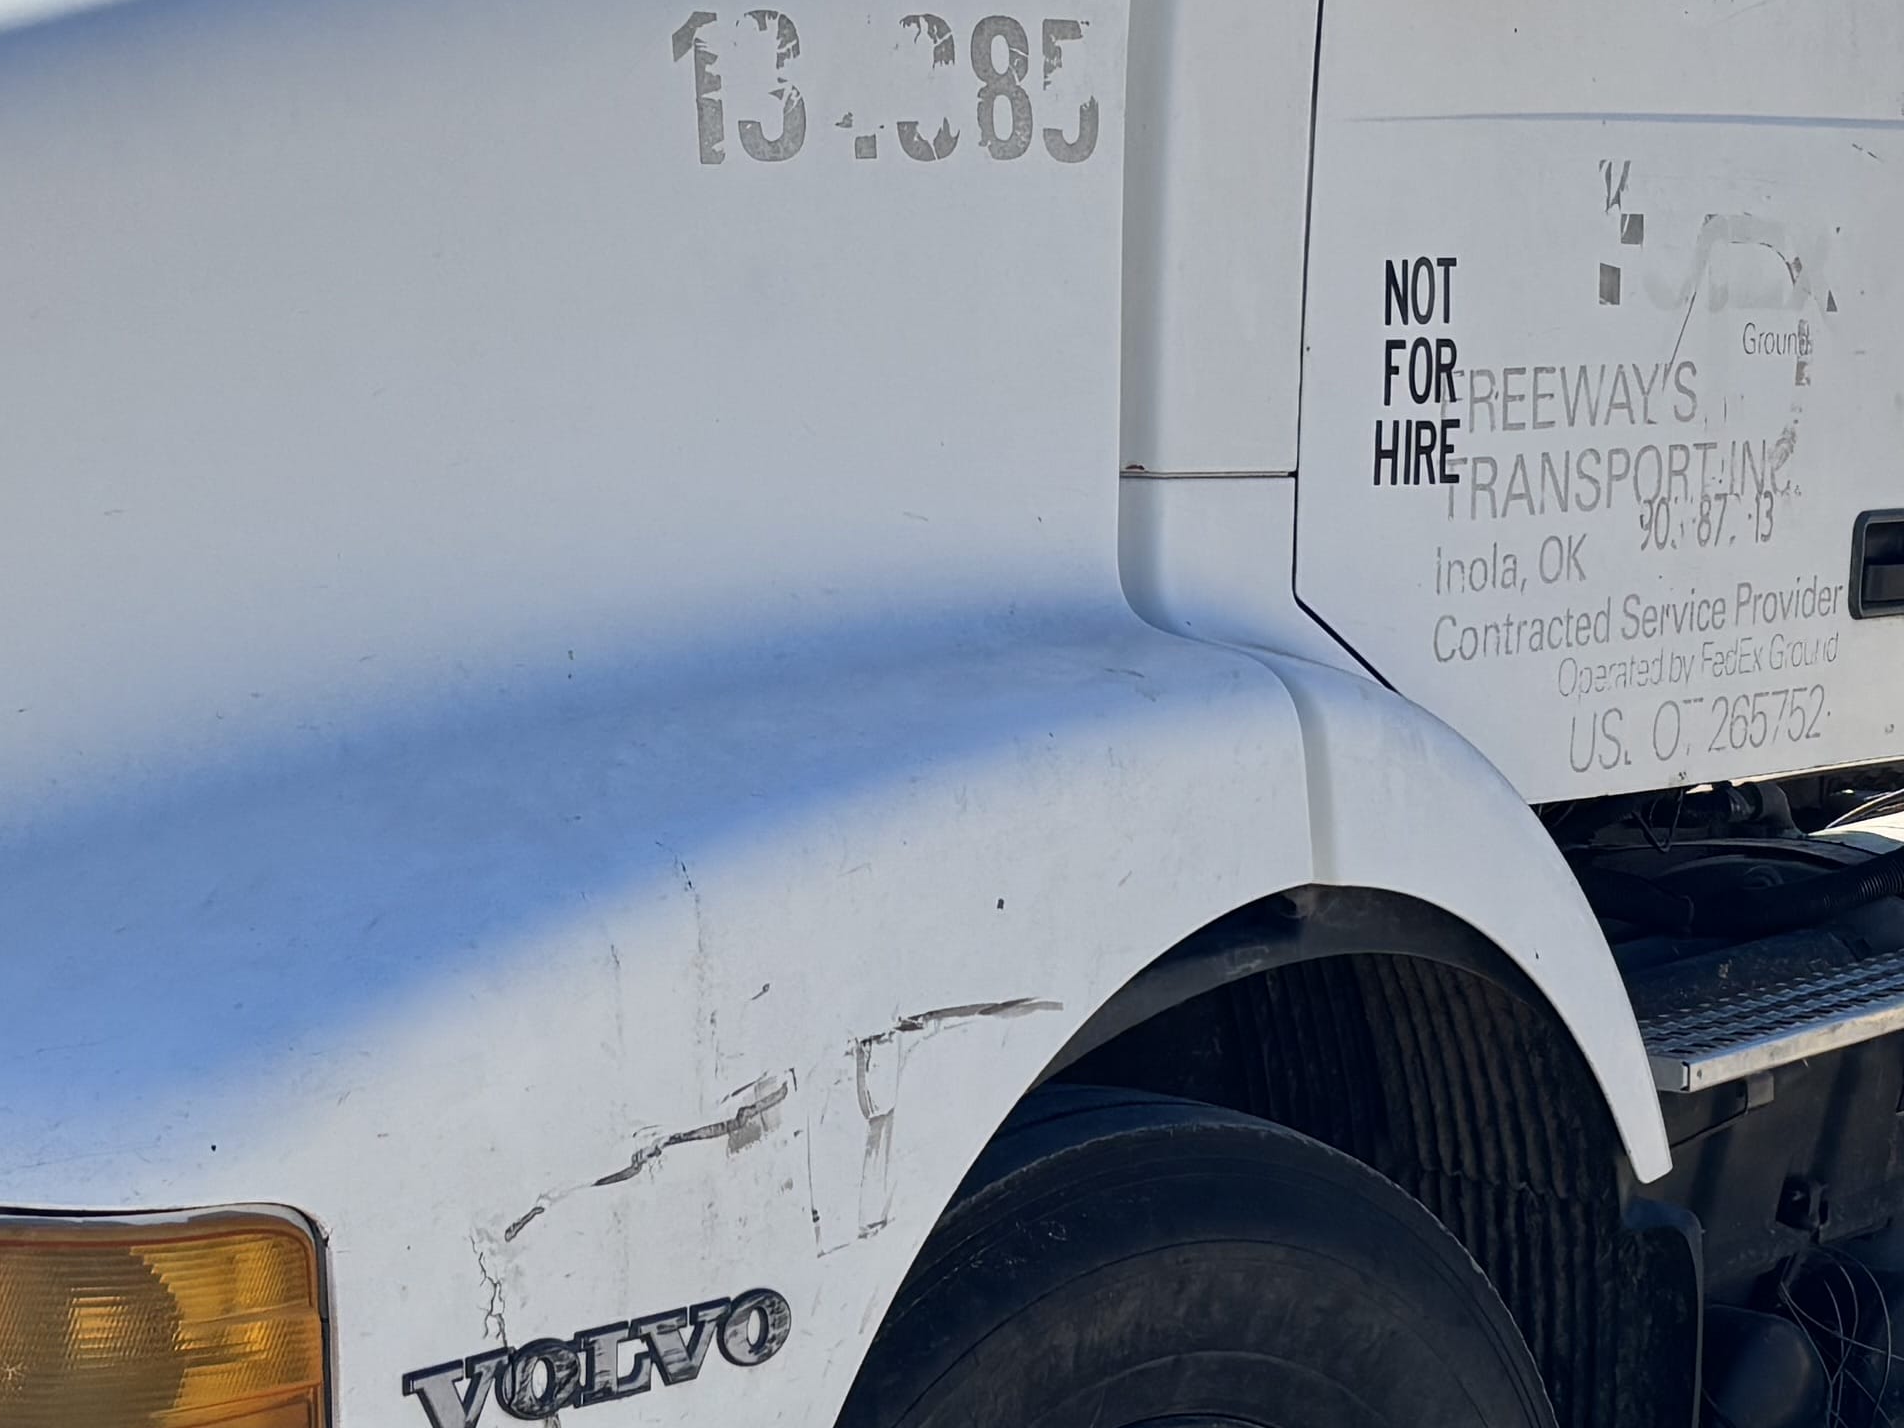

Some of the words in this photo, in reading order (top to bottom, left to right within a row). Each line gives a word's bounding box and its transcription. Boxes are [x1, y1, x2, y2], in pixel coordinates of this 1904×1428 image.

[672, 10, 1099, 164] 13385
[1385, 256, 1457, 326] NOT
[1384, 337, 1458, 406] FOR
[1742, 322, 1811, 356] Ground
[1373, 418, 1461, 486] HIRE
[1539, 533, 1587, 584] OK
[1433, 595, 1610, 663] Contracted
[1621, 587, 1726, 641] Service
[1735, 575, 1844, 627] Provider
[1558, 647, 1665, 704] Operated
[1669, 652, 1696, 685] by
[1702, 636, 1764, 677] FedEx
[1707, 684, 1825, 753] 265752
